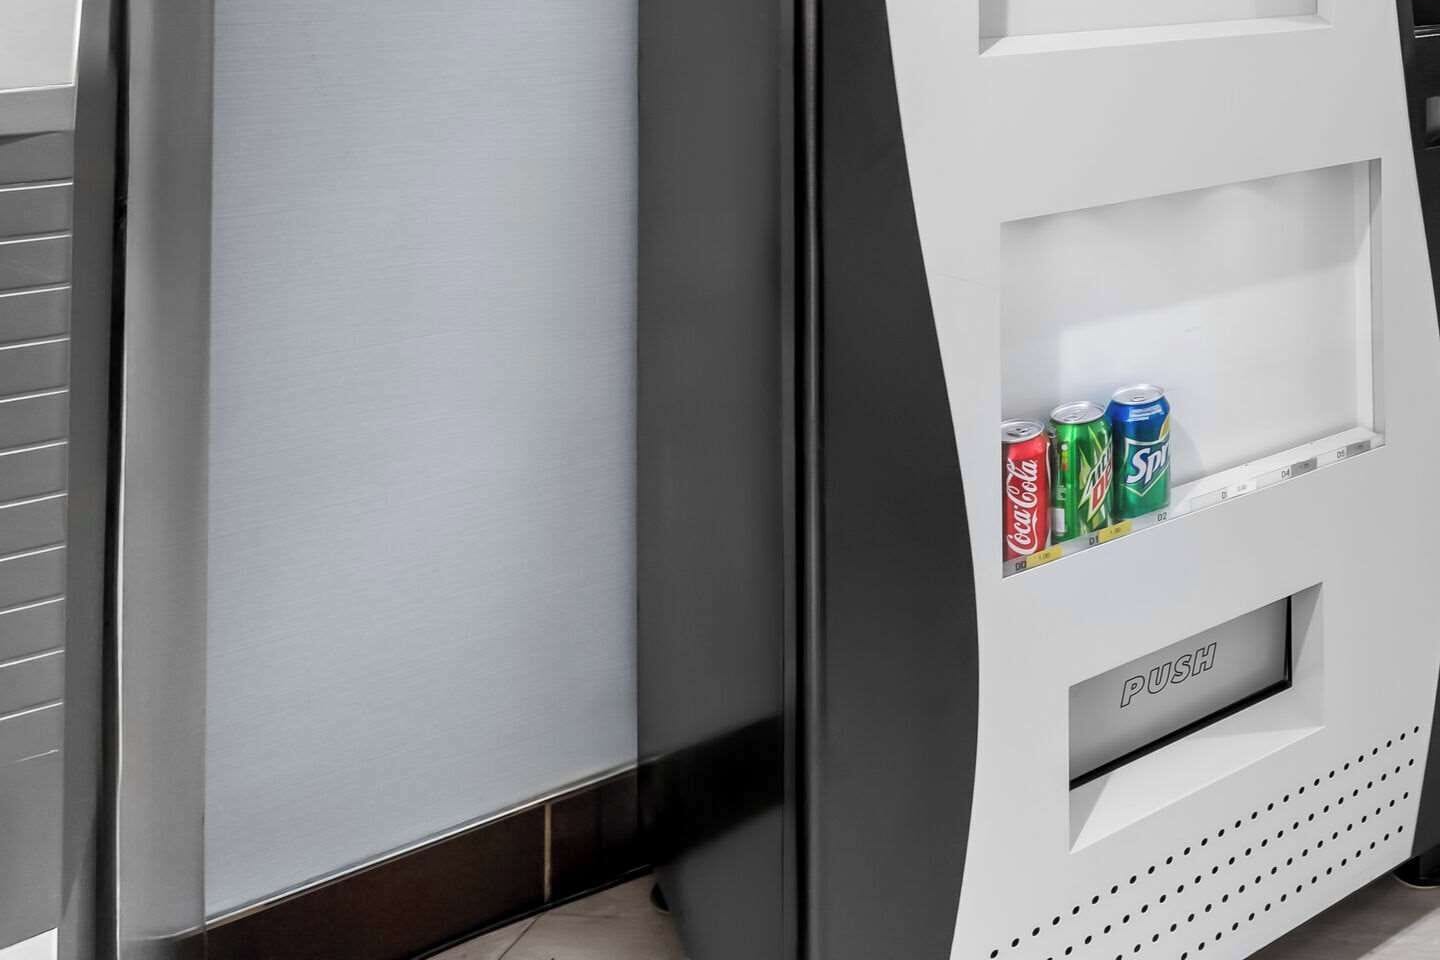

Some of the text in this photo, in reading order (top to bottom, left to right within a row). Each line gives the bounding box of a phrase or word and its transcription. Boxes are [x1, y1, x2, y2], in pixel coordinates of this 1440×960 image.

[1126, 442, 1170, 485] Spr
[1281, 468, 1290, 479] D4
[1157, 511, 1168, 522] D2
[1089, 535, 1099, 546] D1
[1120, 641, 1217, 708] PUSH
